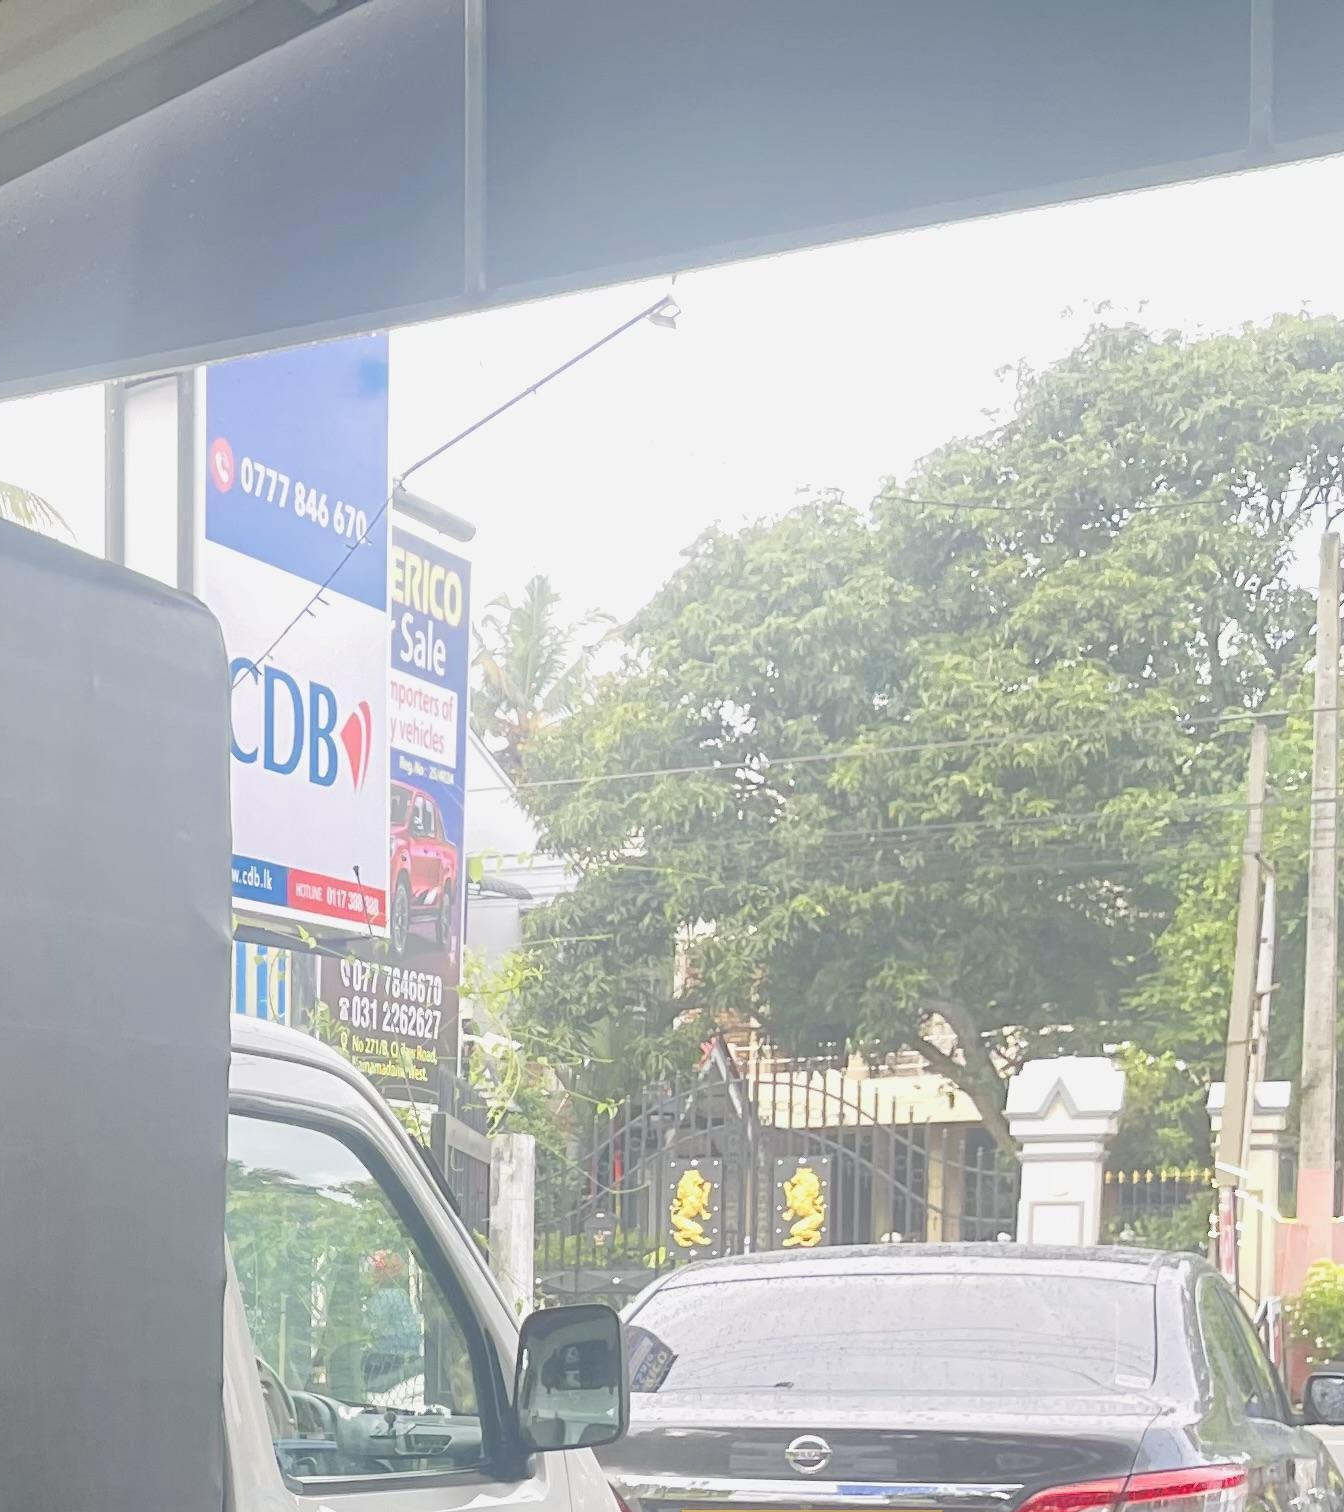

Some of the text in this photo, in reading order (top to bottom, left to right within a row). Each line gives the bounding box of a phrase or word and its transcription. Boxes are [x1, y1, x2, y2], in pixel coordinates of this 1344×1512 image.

[240, 457, 368, 542] 0777 846 670
[391, 545, 462, 627] ERICO
[400, 612, 446, 677] Sale
[231, 657, 339, 788] CDB
[442, 696, 453, 720] of
[400, 718, 444, 754] vehicles
[352, 959, 442, 1006] 077 7846670
[352, 996, 377, 1030] 031
[352, 1035, 364, 1053] No
